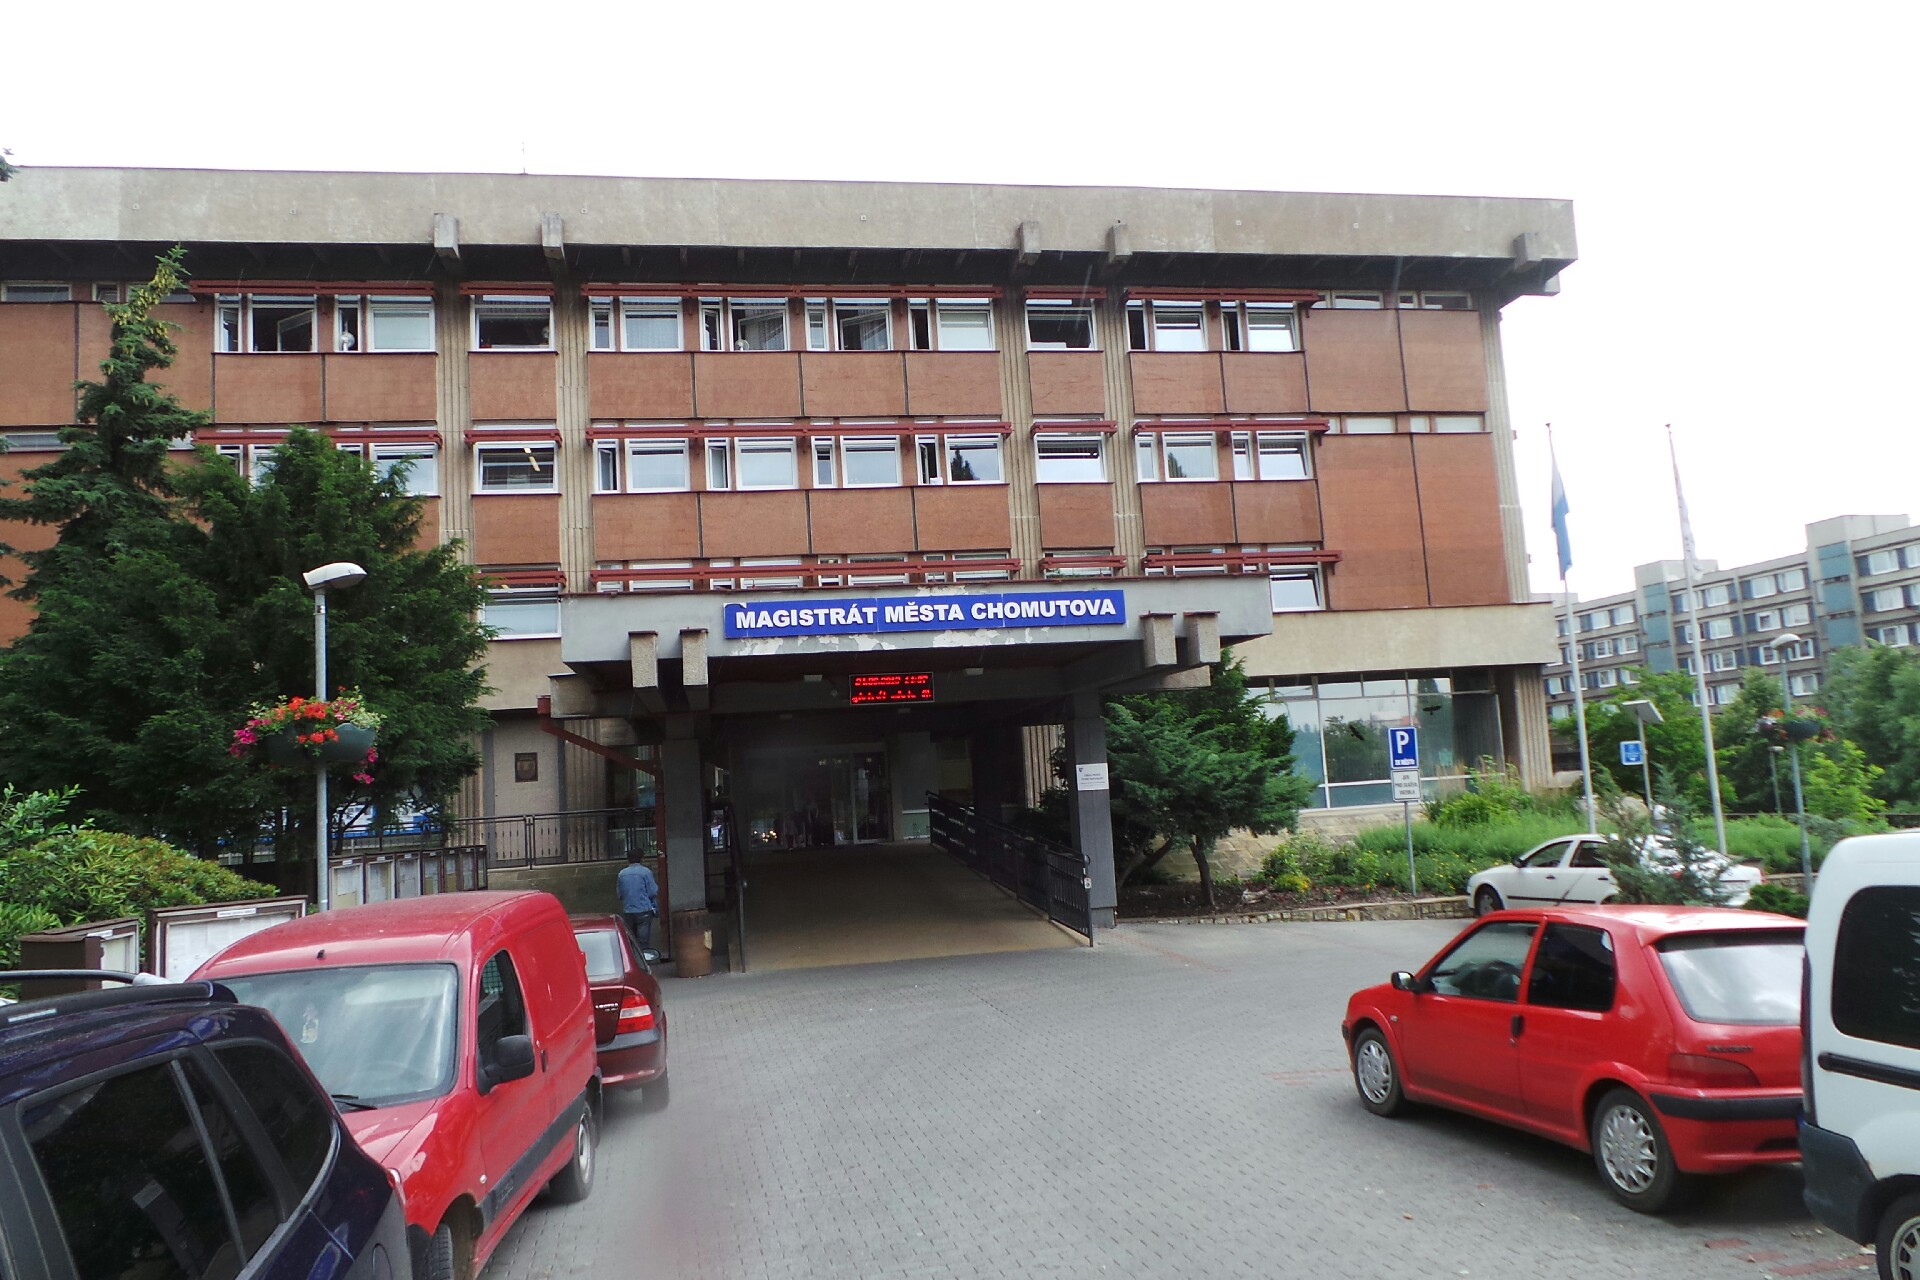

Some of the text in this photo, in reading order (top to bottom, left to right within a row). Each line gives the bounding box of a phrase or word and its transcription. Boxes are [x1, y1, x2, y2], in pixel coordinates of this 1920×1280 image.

[736, 599, 1117, 629] MAGISTRÁT MĚSTA CHOMUTOVA
[1396, 731, 1409, 754] P
